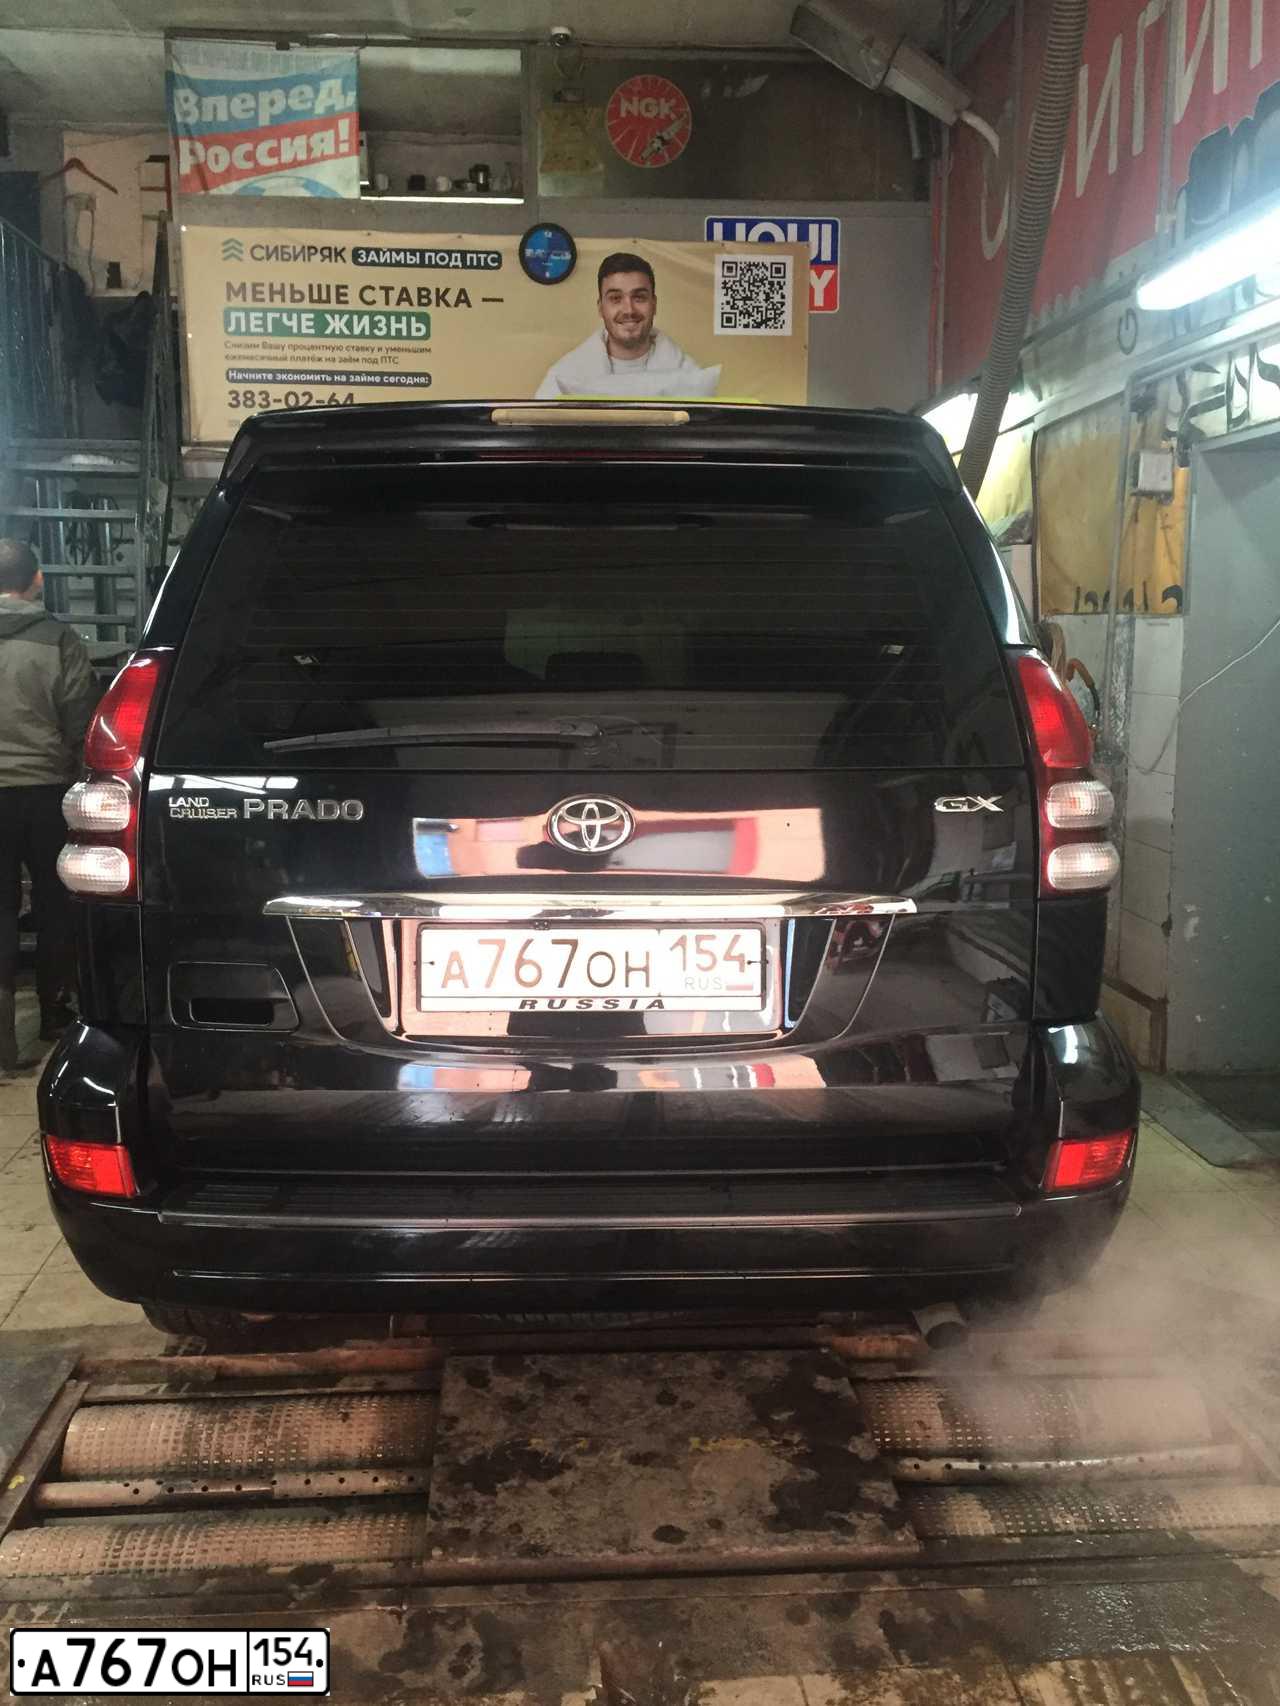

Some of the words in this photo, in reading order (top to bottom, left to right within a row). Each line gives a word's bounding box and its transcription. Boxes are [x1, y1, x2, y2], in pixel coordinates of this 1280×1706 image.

[173, 78, 356, 127] Вперед,
[620, 95, 677, 121] NGK
[178, 118, 350, 176] Россия!
[250, 244, 346, 263] СИБИРЯК
[357, 249, 420, 264] ЗАЙМЫ
[424, 251, 462, 268] ПОД
[466, 253, 499, 267] ПТС
[226, 281, 349, 305] МЕНЬШЕ
[358, 285, 472, 308] СТАВКА
[228, 311, 315, 334] ЛЕГЧЕ
[324, 313, 427, 337] ЖИЗНЬ
[346, 345, 375, 355] ставку
[385, 346, 432, 356] уменьшим
[361, 356, 379, 366] под
[380, 355, 399, 365] ПТС
[228, 369, 273, 382] Начните
[275, 373, 332, 383] экономить
[334, 374, 347, 383] на
[349, 373, 382, 383] займе
[383, 375, 429, 386] сегодня:
[227, 389, 355, 409] 383-02-64
[168, 796, 209, 807] LAND
[243, 798, 364, 821] PRADO
[934, 796, 1004, 812] GX
[169, 807, 237, 819] CRUISER
[669, 934, 747, 973] 154
[684, 976, 723, 991] RUS
[518, 998, 665, 1010] RUSSIA
